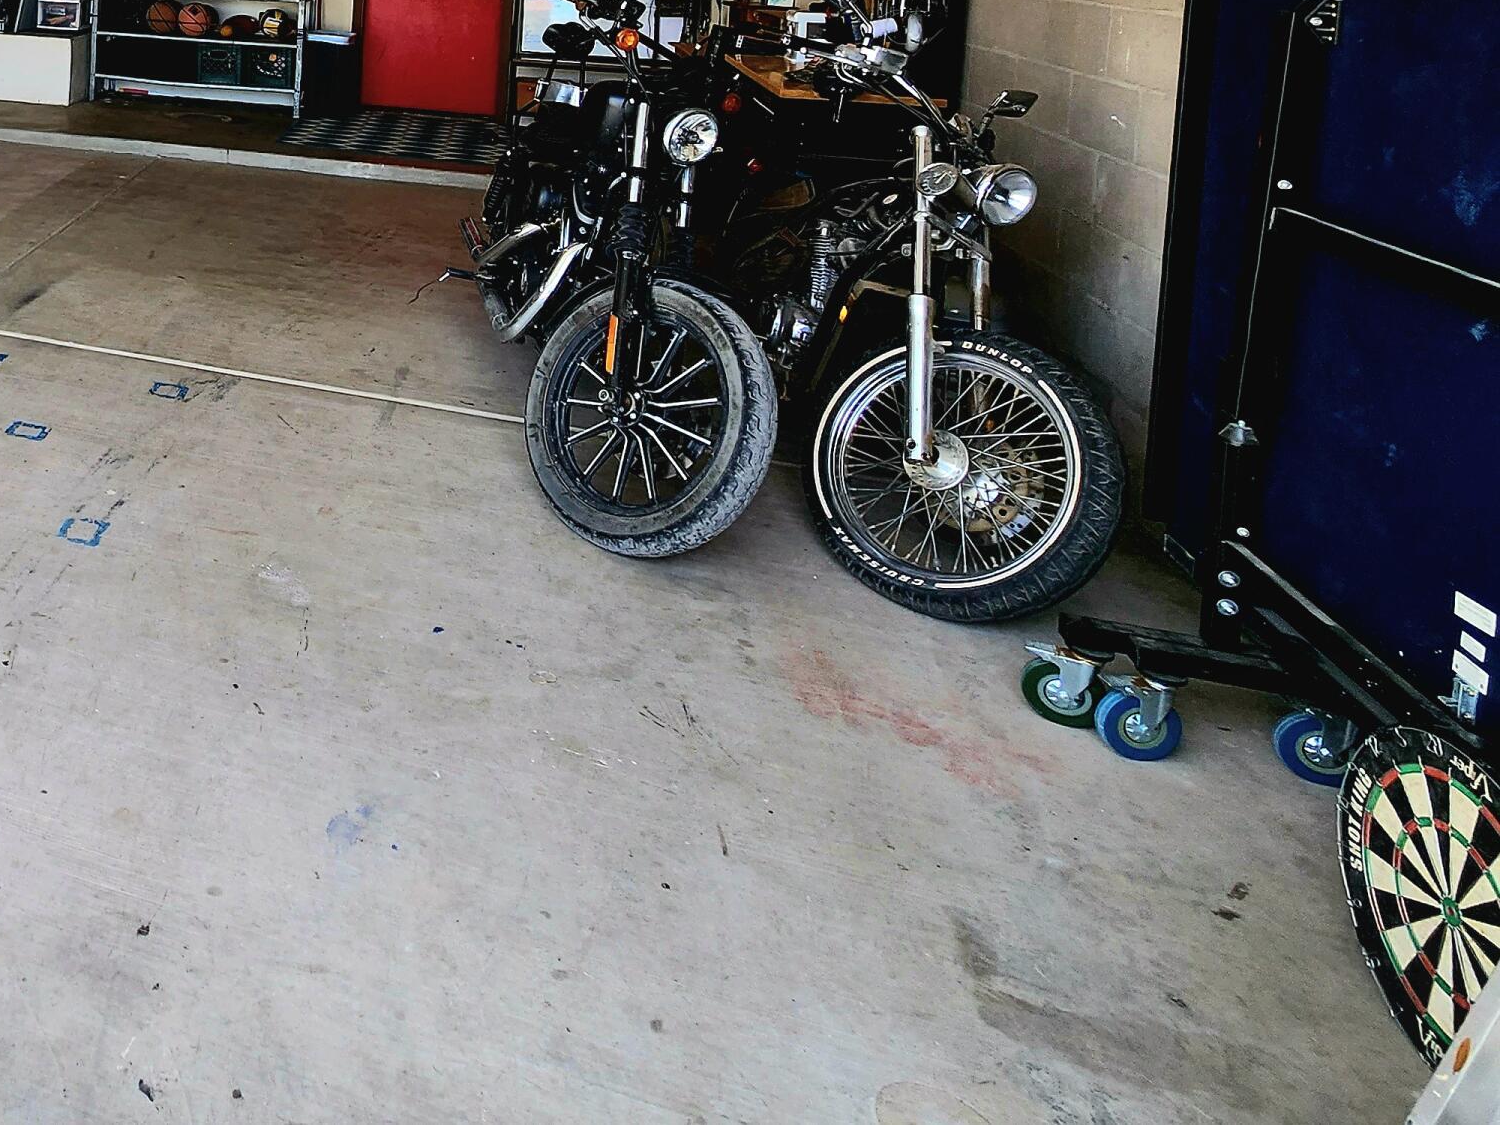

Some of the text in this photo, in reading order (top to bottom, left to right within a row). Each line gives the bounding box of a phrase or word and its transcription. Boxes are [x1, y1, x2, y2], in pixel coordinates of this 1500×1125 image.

[960, 340, 1034, 376] DUNLOP
[831, 525, 927, 587] CRUISEMAX
[1449, 755, 1494, 804] Viper
[1347, 766, 1373, 873] SHOT KING
